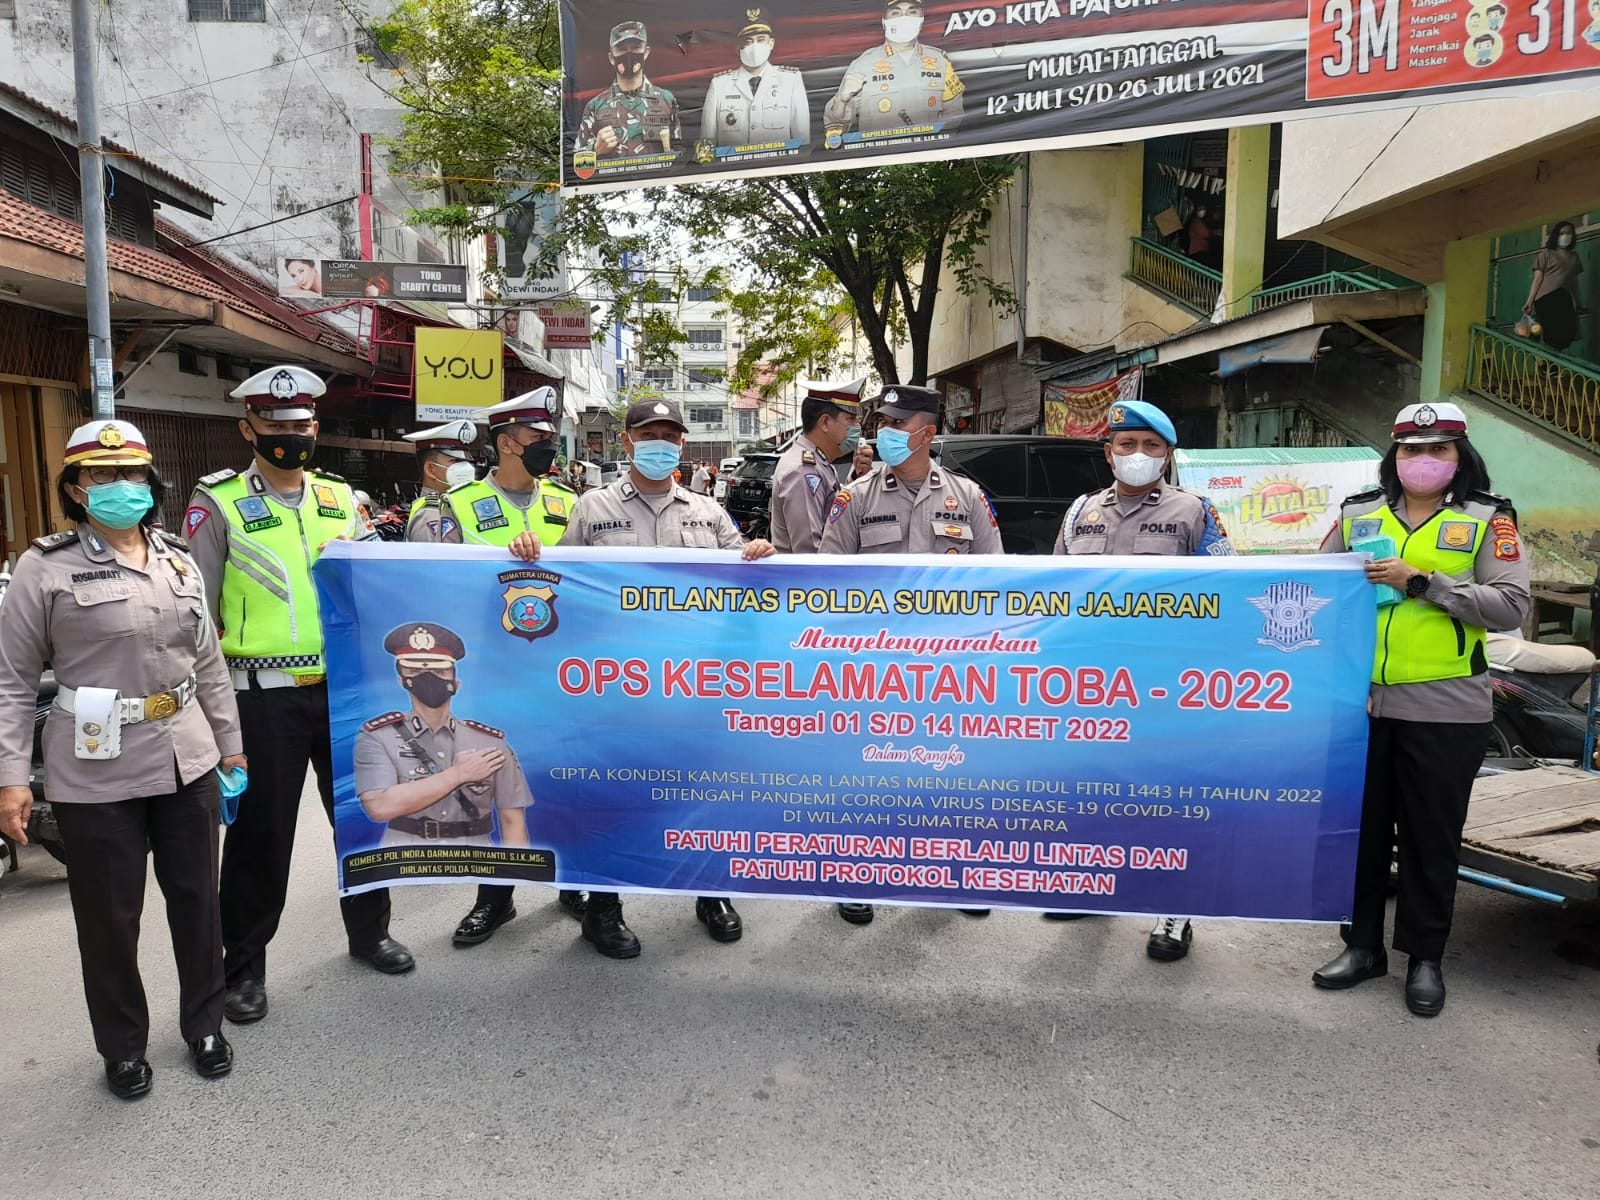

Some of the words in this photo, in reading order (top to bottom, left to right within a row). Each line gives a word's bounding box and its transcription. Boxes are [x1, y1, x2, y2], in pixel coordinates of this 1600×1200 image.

[944, 8, 997, 37] AYO
[1006, 3, 1061, 25] KITA
[1410, 12, 1458, 25] Menjaga
[1321, 0, 1400, 77] 3M
[1409, 26, 1440, 38] Jarak
[1409, 40, 1460, 55] Memakai
[1408, 56, 1448, 68] Masker
[872, 74, 895, 82] RIKO
[987, 96, 1007, 117] 12
[1012, 89, 1063, 115] JULI
[1067, 81, 1114, 108] S/D
[1153, 71, 1206, 97] JULI
[420, 270, 442, 281] TOKO
[400, 282, 431, 292] BEAUTY
[432, 283, 463, 294] CENTRE
[561, 317, 586, 329] INDAH
[935, 511, 968, 522] POLRI
[1240, 486, 1329, 524] HATARI
[1139, 523, 1177, 534] POLRI
[500, 571, 536, 582] SUMATERA
[537, 572, 559, 583] UTARA
[620, 586, 780, 612] DITLANTAS
[787, 588, 889, 613] POLDA
[895, 590, 1000, 615] SUMUT
[1006, 591, 1071, 616] DAN
[1077, 592, 1220, 618] JAJARAN
[791, 626, 1041, 655] Menyelenggarakan
[557, 656, 650, 697] OPS
[662, 658, 997, 704] KESELAMATAN
[1008, 665, 1140, 708] TOBA
[1149, 686, 1168, 698] -
[1178, 668, 1292, 711] 2022
[722, 709, 825, 738] Tanggal
[831, 710, 861, 735] 01
[868, 711, 916, 737] S/D
[923, 713, 954, 738] 14
[960, 715, 1060, 741] MARET
[1066, 717, 1132, 743] 2022
[862, 743, 908, 763] Dalam
[910, 746, 966, 771] Rangka
[550, 767, 601, 781] CIPTA
[606, 768, 682, 783] KONDISI
[688, 770, 823, 787] KAMSELTIBCAR
[829, 774, 900, 790] LANTAS
[906, 776, 1020, 793] MENJELANG
[1025, 780, 1070, 795] IDUL
[1075, 781, 1121, 797] FITRI
[1127, 783, 1172, 799] 1443
[1179, 785, 1193, 799] H
[1200, 786, 1270, 802] TAHUN
[1275, 788, 1323, 803] 2022
[651, 787, 744, 802] DITENGAH
[751, 789, 836, 806] PANDEMI
[841, 792, 925, 809] CORONA
[930, 796, 985, 810] VIRUS
[991, 797, 1098, 814] DISEASE-19
[1103, 802, 1211, 822] (COVID-19)
[783, 809, 801, 823] DI
[807, 810, 891, 825] WILAYAH
[897, 812, 999, 831] SUMATERA
[1005, 817, 1069, 832] UTARA
[349, 853, 382, 867] KOMBES
[383, 851, 399, 860] POL
[401, 850, 426, 859] INDRA
[426, 849, 471, 859] DARMAWAN
[664, 829, 750, 853] PATUHI
[756, 832, 905, 859] PERATURAN
[910, 837, 1029, 864] BERLALU
[1034, 842, 1125, 868] LINTAS
[1130, 846, 1188, 871] DAN
[399, 865, 443, 875] DIRLANTAS
[444, 864, 470, 875] POLDA
[470, 865, 496, 875] SUMUT
[730, 857, 815, 882] PATUHI
[821, 861, 958, 888] PROTOKOL
[963, 867, 1115, 895] KESEHATAN
